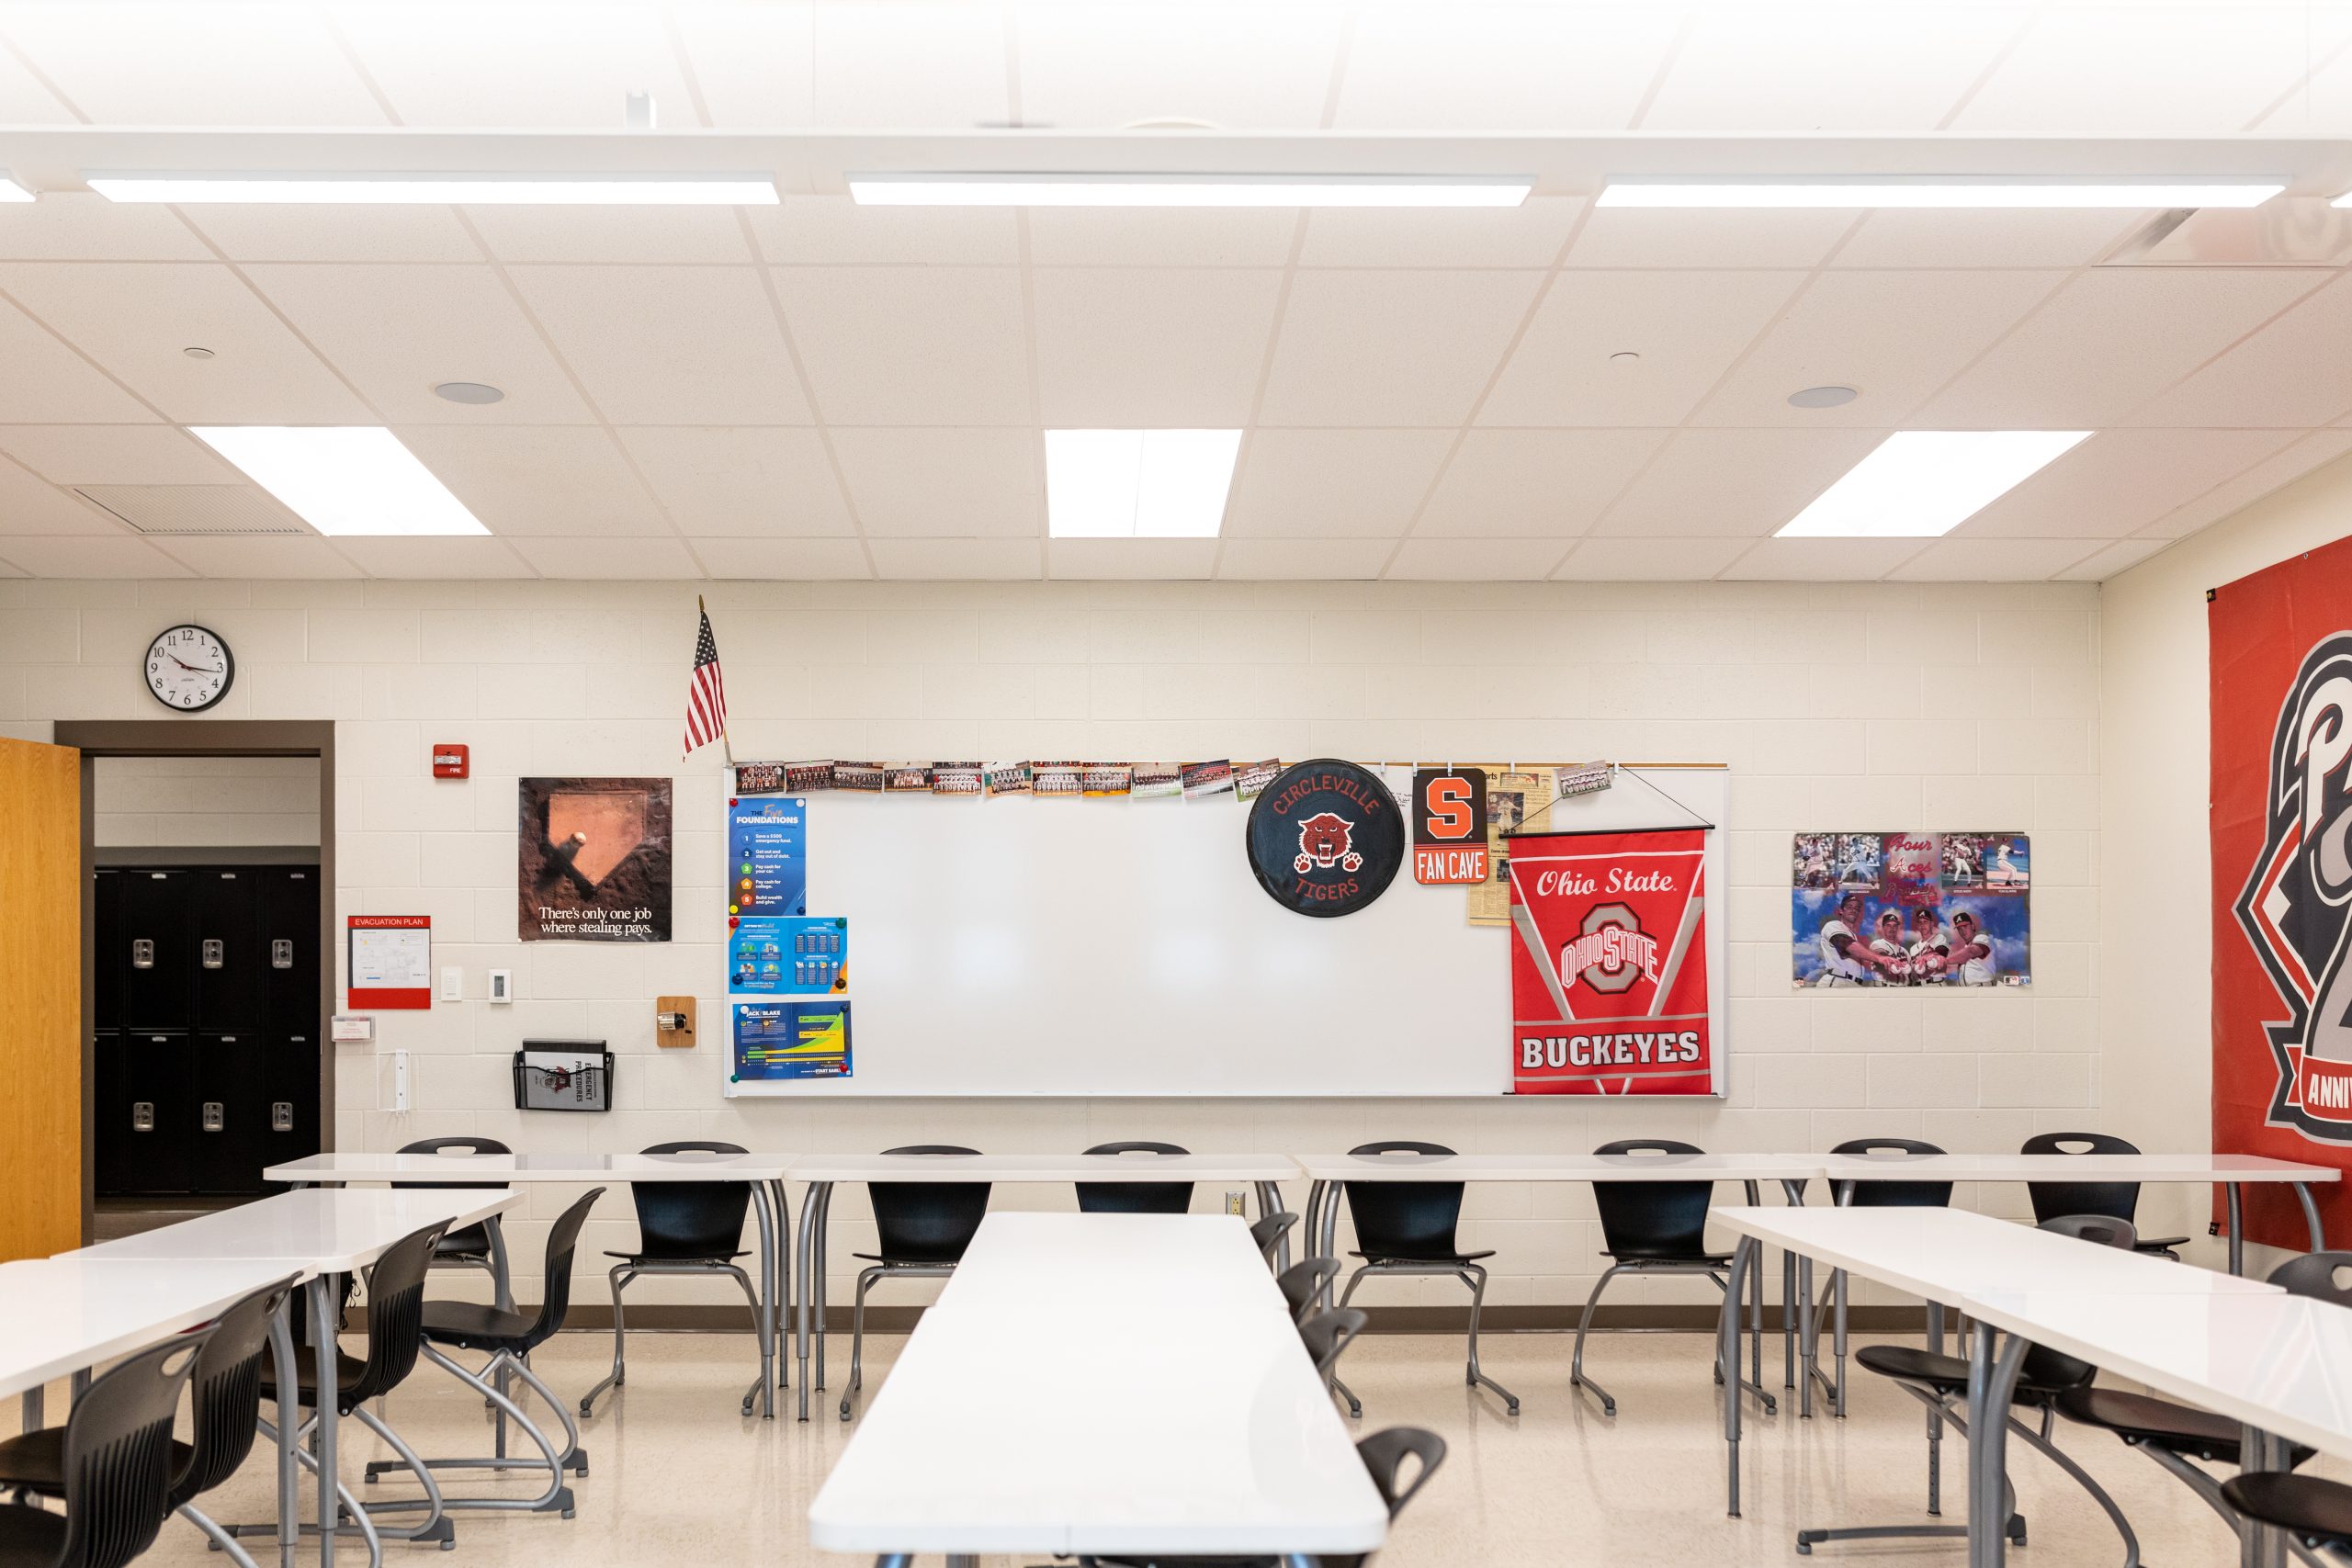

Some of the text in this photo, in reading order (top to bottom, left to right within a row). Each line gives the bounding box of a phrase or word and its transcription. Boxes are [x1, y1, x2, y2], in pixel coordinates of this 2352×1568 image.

[182, 630, 194, 640] 12
[200, 636, 205, 645] 1
[168, 636, 176, 646] 11
[153, 647, 164, 658] 10
[211, 647, 219, 657] 2
[151, 663, 158, 673] 9
[217, 662, 224, 672] 3
[155, 678, 163, 688] 8
[211, 678, 219, 688] 4
[169, 691, 175, 701] 7
[184, 694, 191, 705] 6
[199, 691, 206, 701] 5
[1273, 775, 1380, 815] CIRCLEVILLE
[1427, 777, 1473, 839] S
[1890, 834, 1932, 852] Four
[1418, 852, 1485, 880] FAN CAVE
[1890, 856, 1932, 872] Aces
[1537, 868, 1674, 897] Ohio State
[1295, 878, 1359, 900] TIGERS
[582, 907, 606, 922] only
[610, 909, 631, 919] one
[632, 908, 651, 922] job
[541, 920, 652, 936] where stealing pays.
[1521, 1032, 1700, 1068] BUCKEYES
[2307, 1073, 2352, 1109] ANNI
